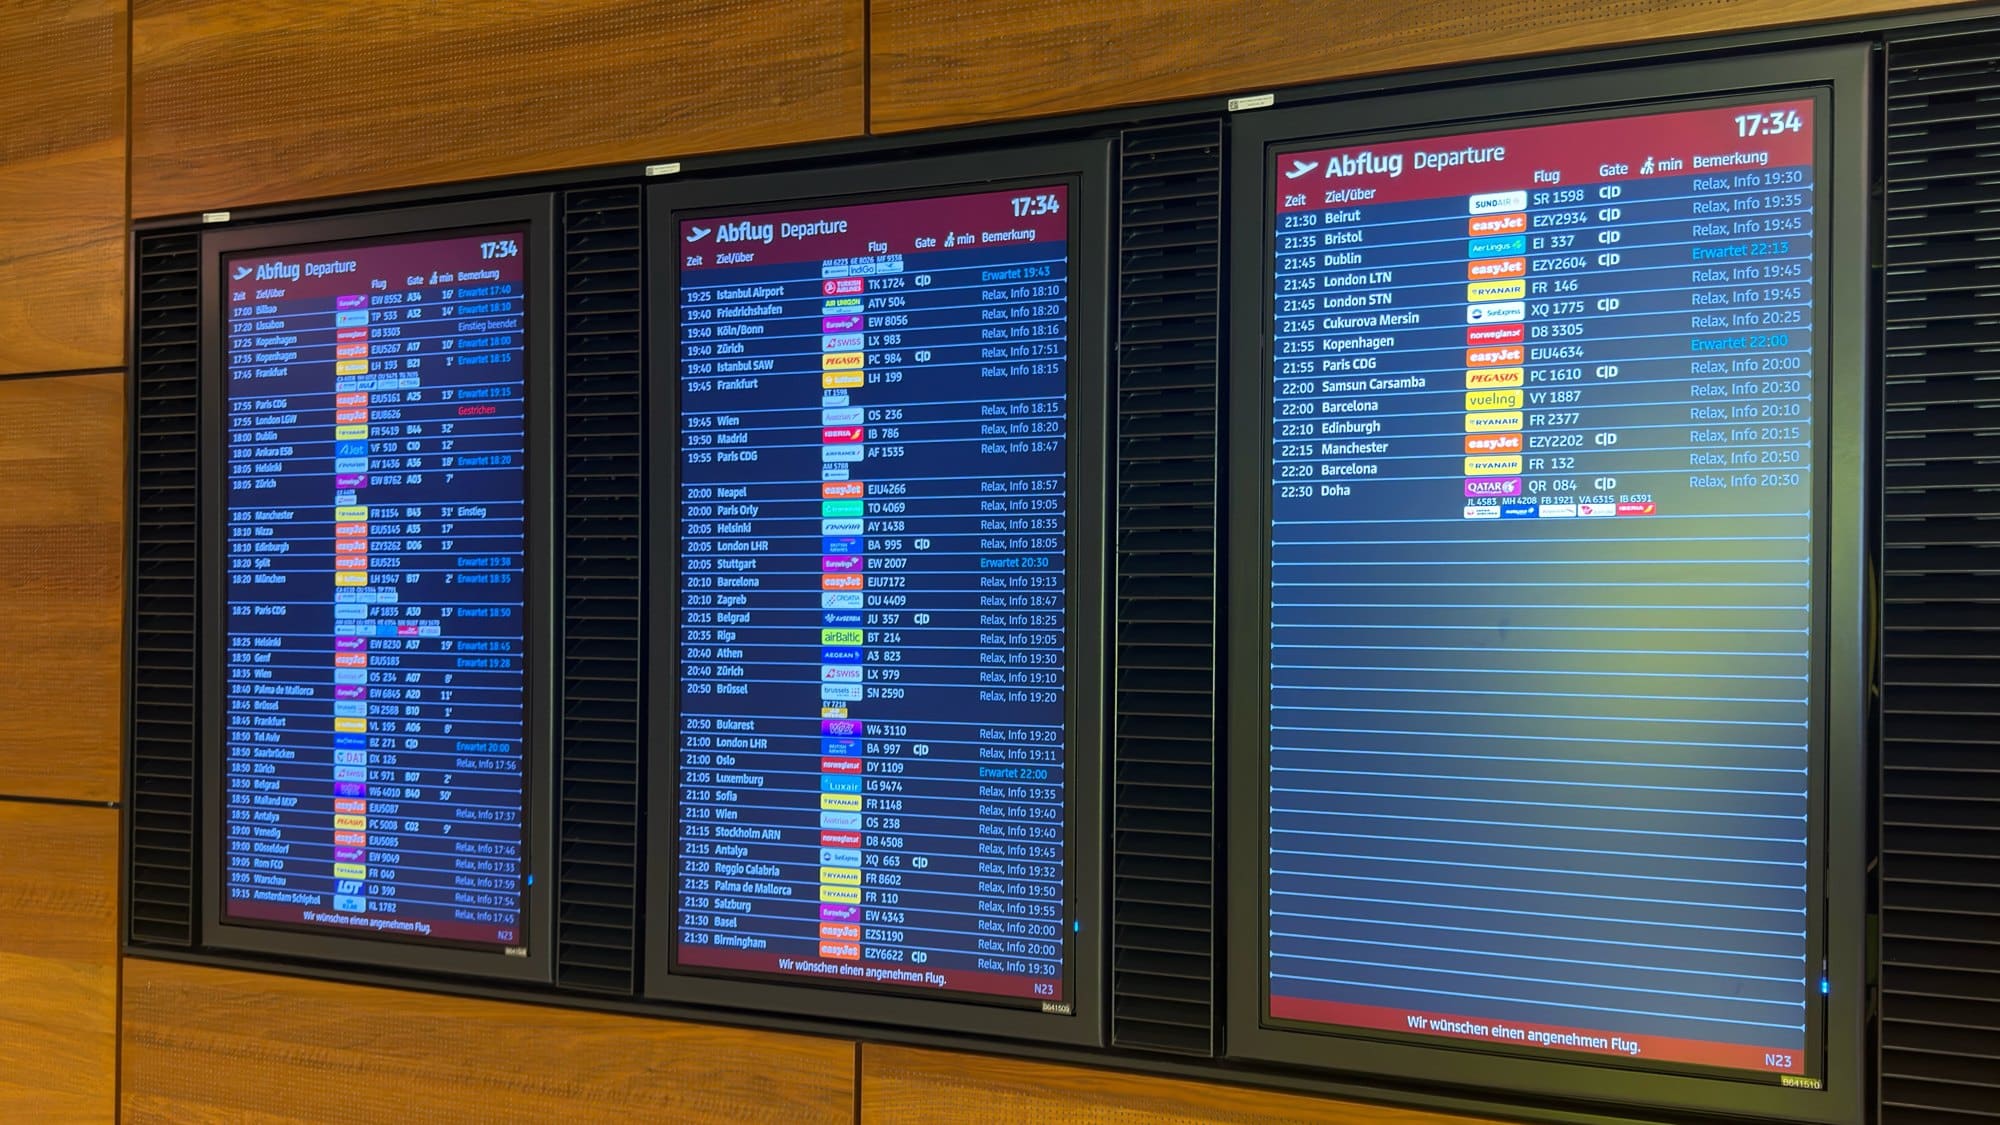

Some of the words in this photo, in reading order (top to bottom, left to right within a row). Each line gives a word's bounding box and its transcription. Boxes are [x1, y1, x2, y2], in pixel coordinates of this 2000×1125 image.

[1735, 111, 1802, 137] 17:34
[1325, 153, 1403, 178] Abflug
[1414, 146, 1505, 171] Departure
[1284, 194, 1306, 207] Zeit
[1325, 188, 1376, 204] Ziel/über
[1534, 170, 1560, 184] Flug
[1600, 164, 1628, 177] Gate
[1658, 158, 1683, 171] min
[1693, 152, 1768, 168] Bemerkung
[1011, 194, 1059, 217] 17:34
[1284, 215, 1316, 228] 21:30
[1325, 210, 1361, 224] Beirut
[1533, 192, 1549, 205] SR
[1553, 190, 1584, 203] 1598
[1693, 179, 1730, 192] Relax,
[1734, 174, 1760, 188] Info
[1765, 171, 1802, 185] 19:30
[716, 222, 773, 244] Abflug
[781, 220, 847, 240] Departure
[1284, 257, 1316, 270] 21:45
[1324, 253, 1362, 267] Dublin
[1533, 238, 1544, 249] EI
[1551, 235, 1575, 248] 337
[1693, 225, 1729, 237] Relax,
[1733, 220, 1760, 234] Info
[1764, 218, 1801, 231] 19:45
[480, 240, 518, 259] 17:34
[687, 256, 702, 266] Zeit
[716, 252, 754, 265] Ziel/über
[868, 242, 887, 253] Flug
[915, 237, 936, 248] Gate
[957, 233, 975, 244] min
[982, 229, 1036, 243] Bemerkung
[256, 262, 300, 281] Abflug
[305, 260, 356, 277] Departure
[1284, 277, 1316, 291] 21:45
[1324, 273, 1366, 288] London
[1369, 271, 1392, 283] LTN
[1533, 257, 1587, 272] EZY2604
[1692, 245, 1747, 260] Erwartet
[1750, 241, 1789, 256] 22:13
[233, 292, 246, 301] Zeit
[256, 288, 285, 299] Ziel/über
[371, 280, 387, 290] Flug
[407, 276, 424, 286] Gate
[439, 273, 454, 282] min
[458, 270, 500, 281] Bemerkung
[688, 291, 711, 302] 19:25
[716, 289, 751, 300] Istanbul
[753, 285, 784, 299] Airport
[868, 279, 880, 290] TK
[882, 278, 905, 289] 1724
[982, 269, 1021, 281] Erwartet
[1024, 266, 1050, 278] 19:43
[234, 323, 252, 332] 17:20
[256, 321, 284, 330] Lissabon
[407, 309, 421, 318] A32
[688, 346, 711, 356] 19:40
[716, 343, 744, 354] Zürich
[837, 338, 861, 347] SWISS
[868, 336, 879, 346] LX
[883, 334, 901, 345] 983
[982, 328, 1008, 340] Relax,
[1011, 326, 1029, 337] Info
[1032, 324, 1059, 336] 18:16
[1282, 382, 1314, 395] 22:00
[1322, 380, 1366, 393] Samsun
[1369, 376, 1426, 390] Carsamba
[1470, 372, 1519, 384] PEGASUS
[1530, 370, 1547, 382] PC
[1551, 368, 1582, 381] 1610
[1691, 362, 1728, 374] Relax,
[1732, 359, 1758, 372] Info
[1763, 357, 1800, 370] 20:00
[1282, 402, 1314, 415] 22:00
[1322, 400, 1379, 414] Barcelona
[1470, 393, 1515, 407] vueling
[1529, 392, 1547, 404] VY
[1551, 391, 1582, 403] 1887
[1281, 486, 1313, 498] 22:30
[1321, 485, 1351, 497] Doha
[1468, 482, 1501, 492] QATAR
[1529, 481, 1547, 492] QR
[1553, 479, 1577, 492] 084
[1690, 476, 1727, 489] Relax,
[1731, 474, 1757, 487] Info
[1761, 473, 1799, 486] 20:30
[687, 630, 711, 641] 20:35
[717, 630, 736, 642] Riga
[824, 632, 860, 643] airBaltic
[868, 632, 879, 643] BT
[883, 632, 901, 643] 214
[980, 633, 1007, 645] Relax,
[1008, 633, 1027, 644] Info
[1030, 633, 1057, 645] 19:05
[254, 669, 272, 678] Wien
[406, 673, 420, 682] A07
[254, 748, 295, 759] Saarbrücken
[456, 759, 477, 768] Relax,
[479, 760, 494, 769] Info
[685, 825, 710, 836] 21:15
[715, 826, 760, 839] Stockholm
[761, 829, 781, 840] ARN
[867, 836, 879, 846] D8
[881, 836, 903, 848] 4508
[979, 843, 1005, 855] Relax,
[1007, 844, 1026, 856] Info
[1029, 846, 1056, 858] 19:45
[254, 874, 286, 885] Warschau
[338, 880, 362, 894] LOT
[303, 911, 315, 920] Wir
[316, 912, 349, 924] wünschen
[350, 916, 369, 926] einen
[370, 918, 413, 931] angenehmen
[498, 931, 513, 941] N23
[684, 933, 708, 944] 21:30
[714, 934, 766, 949] Birmingham
[865, 948, 903, 961] EZY6622
[978, 958, 1004, 971] Relax,
[1006, 961, 1026, 972] Info
[1029, 962, 1055, 975] 19:30
[779, 958, 793, 969] Wir
[795, 958, 838, 974] wünschen
[840, 964, 864, 976] einen
[865, 966, 924, 983] angenehmen
[925, 974, 947, 986] Flug.
[1034, 983, 1054, 995] N23
[1407, 1015, 1427, 1030] Wir
[1429, 1017, 1488, 1036] wünschen
[1491, 1025, 1525, 1041] einen
[1528, 1028, 1608, 1049] angenehmen
[1611, 1038, 1641, 1055] Flug.
[1765, 1053, 1792, 1067] N23
